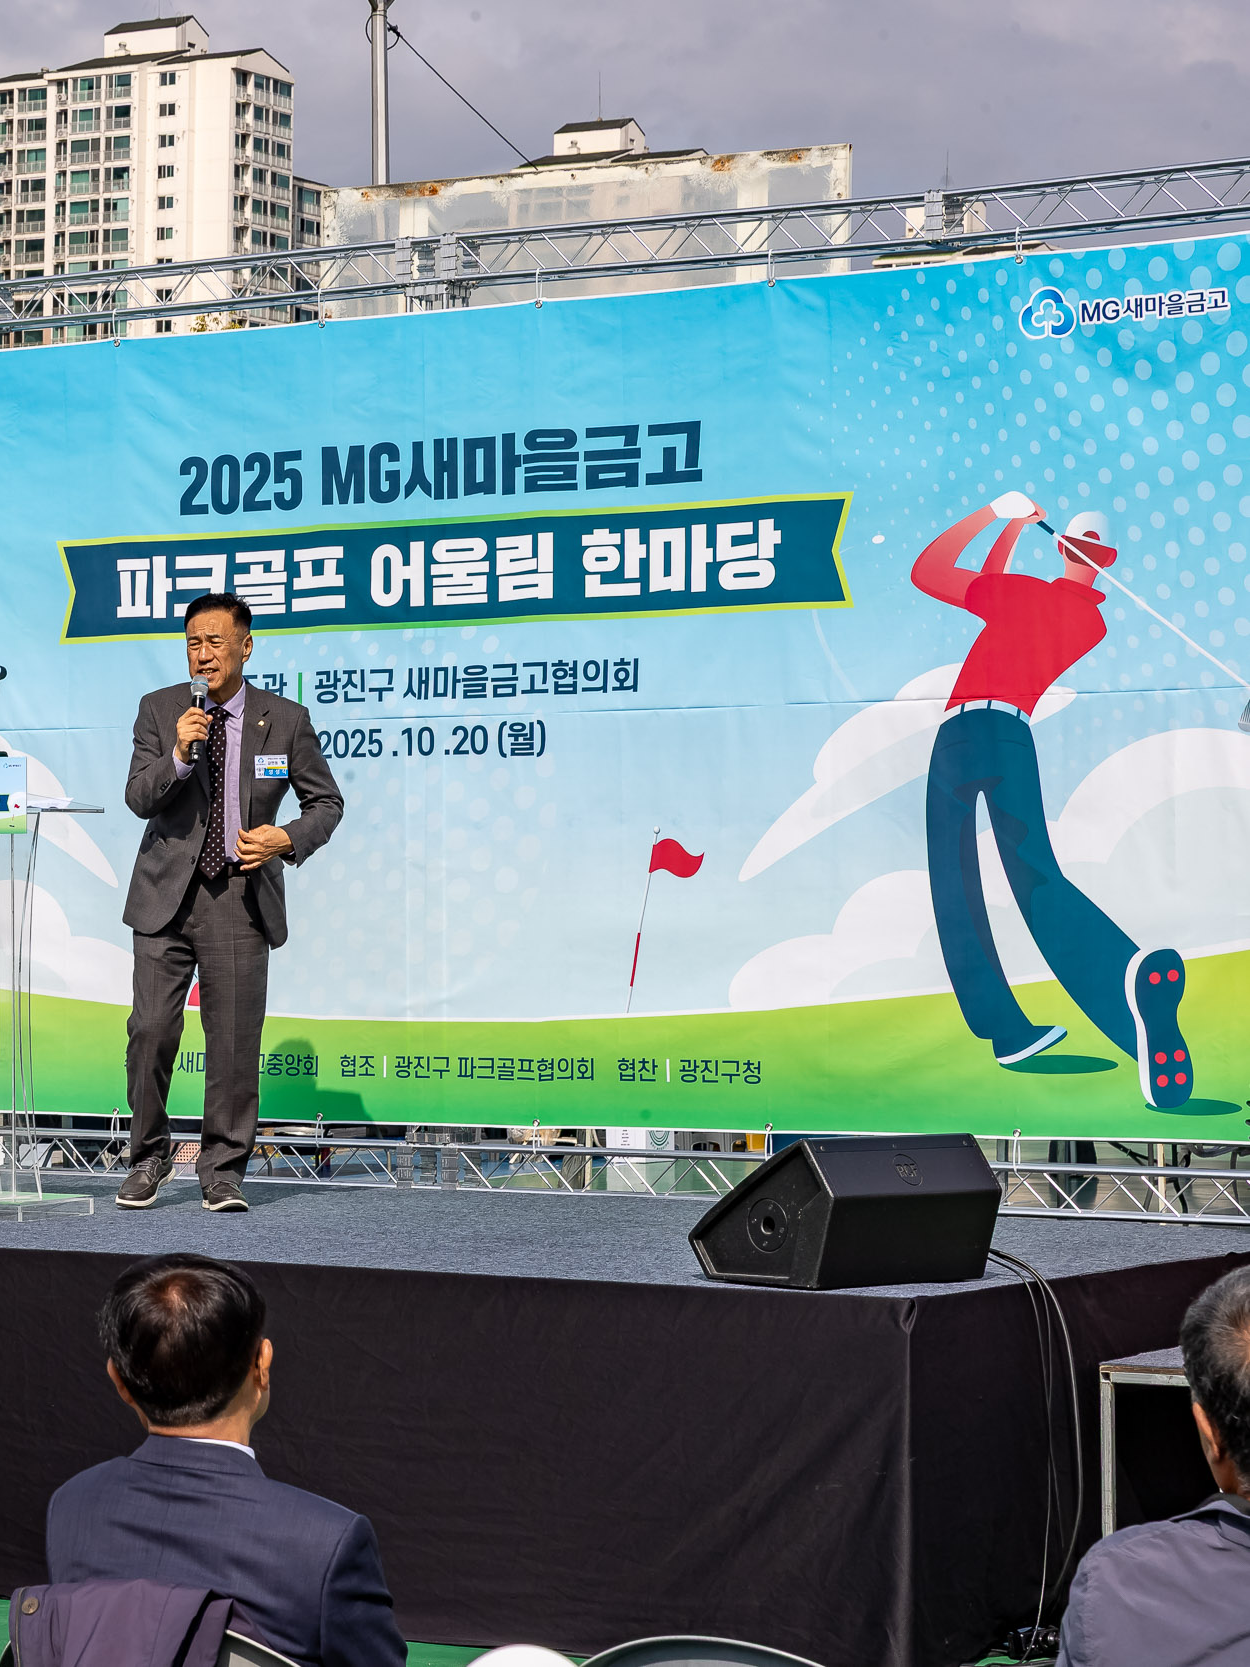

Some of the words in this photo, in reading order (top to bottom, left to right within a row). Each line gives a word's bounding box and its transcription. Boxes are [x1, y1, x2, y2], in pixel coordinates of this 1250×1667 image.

[1081, 290, 1229, 323] MG새마을금고
[178, 450, 303, 516] 2025
[321, 420, 704, 506] MG새마을금고
[116, 545, 345, 618] 파크골프
[369, 531, 555, 608] 어울림
[580, 518, 782, 598] 한마당
[243, 673, 288, 696] 관
[314, 668, 394, 704] 광진구
[402, 658, 639, 701] 새마을금고협의회
[319, 728, 383, 759] 2025
[497, 719, 547, 759] (월)
[340, 1054, 376, 1078] 협조
[394, 1055, 451, 1079] 광진구
[457, 1056, 595, 1082] 파크골프협의회
[617, 1057, 658, 1082] 협찬
[678, 1058, 762, 1085] 광진구청
